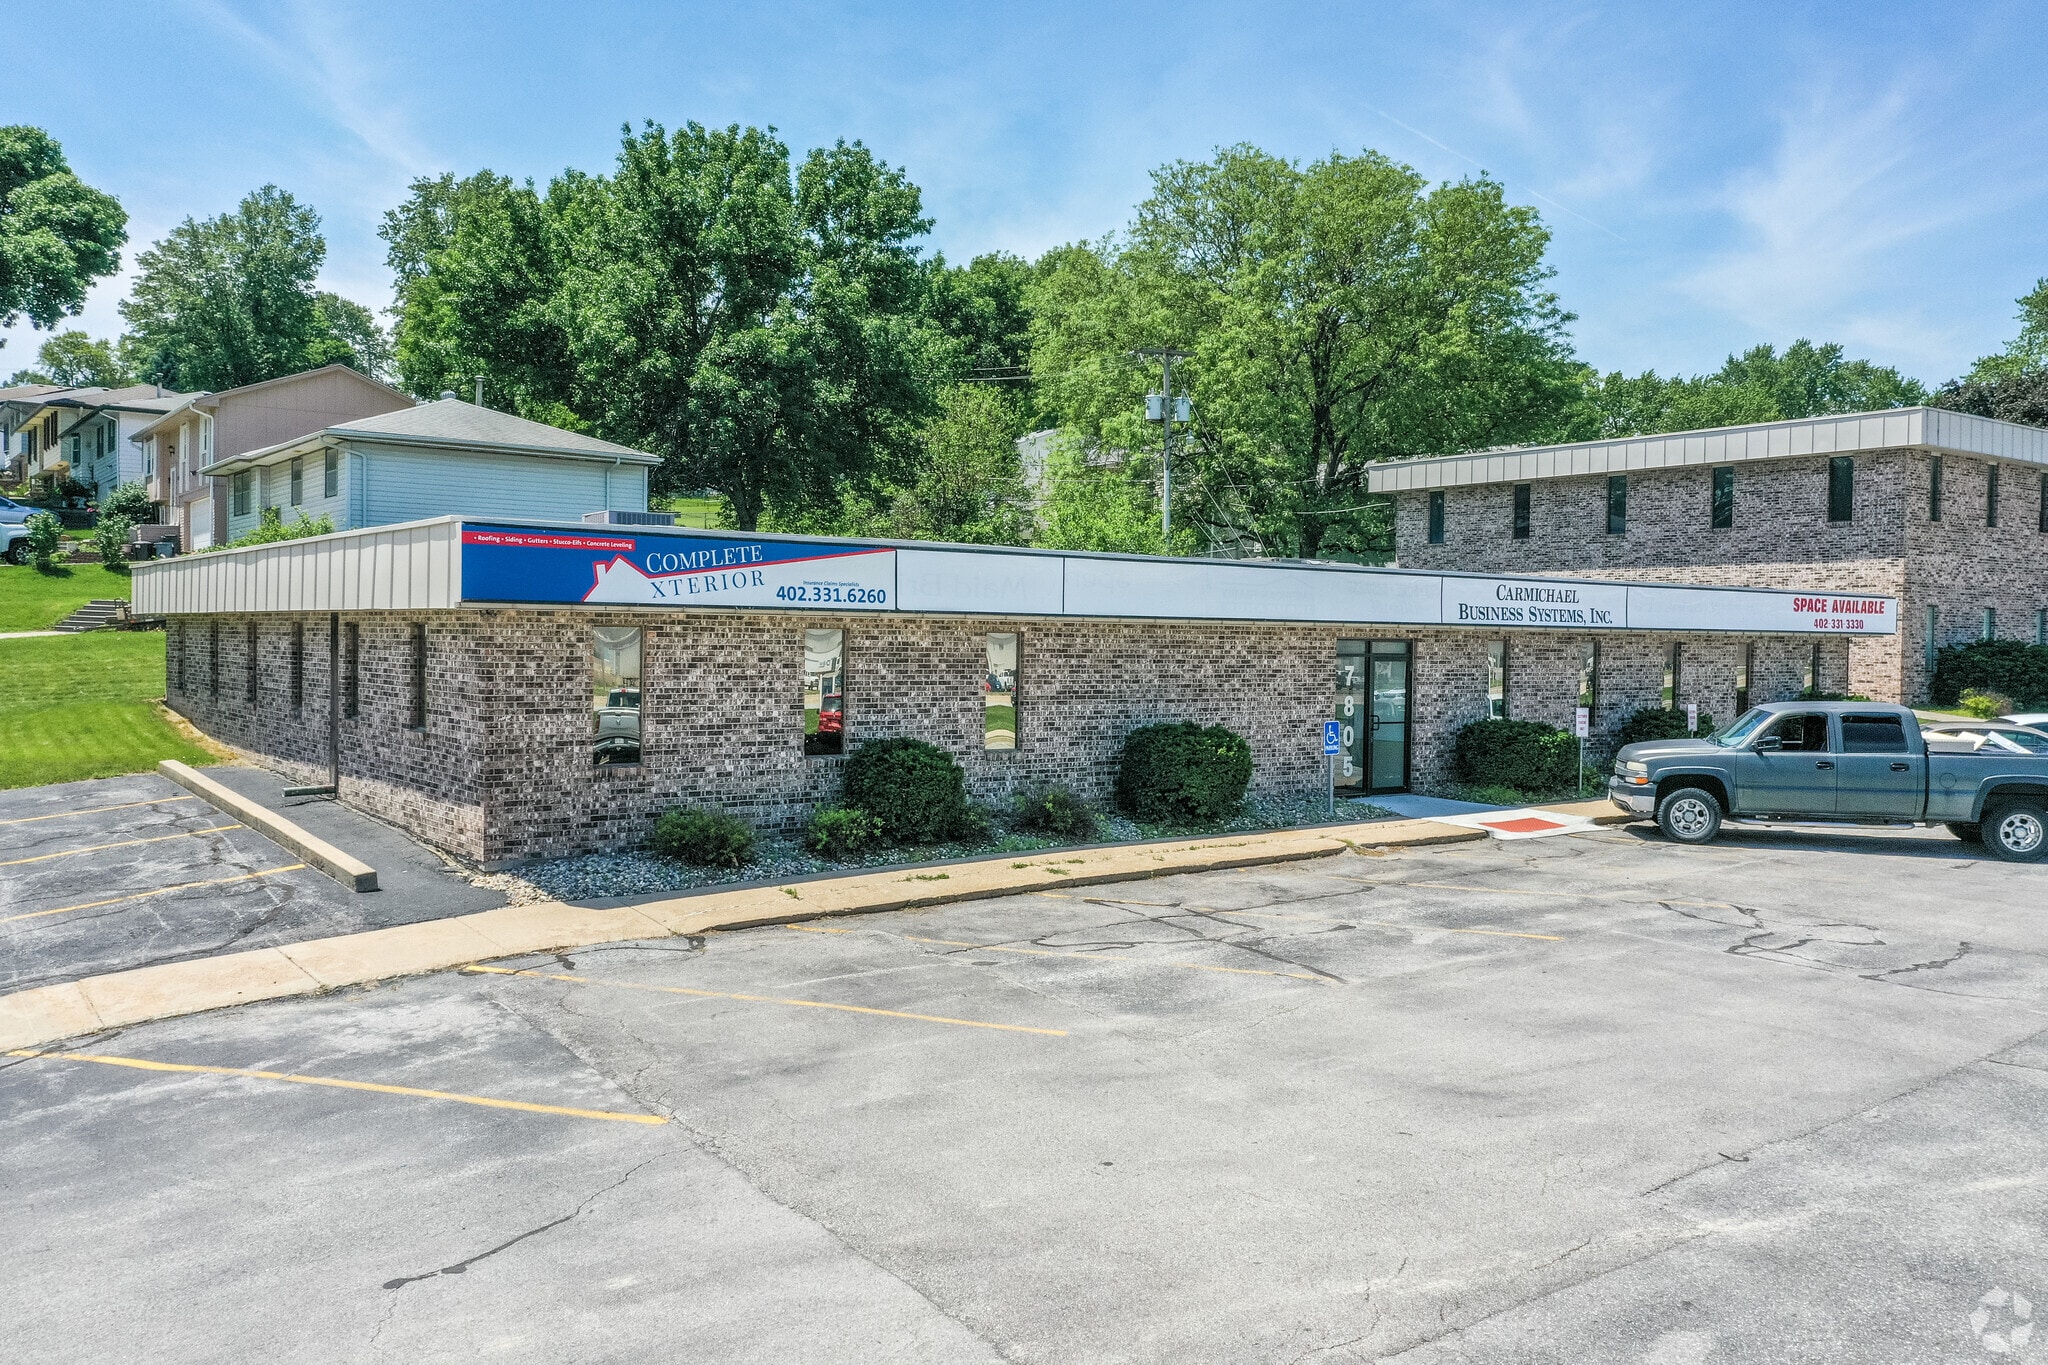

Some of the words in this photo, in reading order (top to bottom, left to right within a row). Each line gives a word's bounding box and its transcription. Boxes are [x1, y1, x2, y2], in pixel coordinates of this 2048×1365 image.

[477, 535, 500, 543] Roofing
[505, 536, 523, 544] Siding
[610, 541, 633, 549] Leveling
[646, 545, 763, 573] COMPLETE
[651, 570, 765, 599] XTERIOR
[776, 585, 886, 604] 402.331.6260
[1496, 584, 1580, 604] CARMICHAEL
[1458, 602, 1524, 621] BUSINESS
[1528, 605, 1587, 625] SYSTEMS,
[1589, 607, 1613, 624] INC.
[1793, 597, 1827, 613] SPACE
[1831, 599, 1885, 614] AVAILABLE
